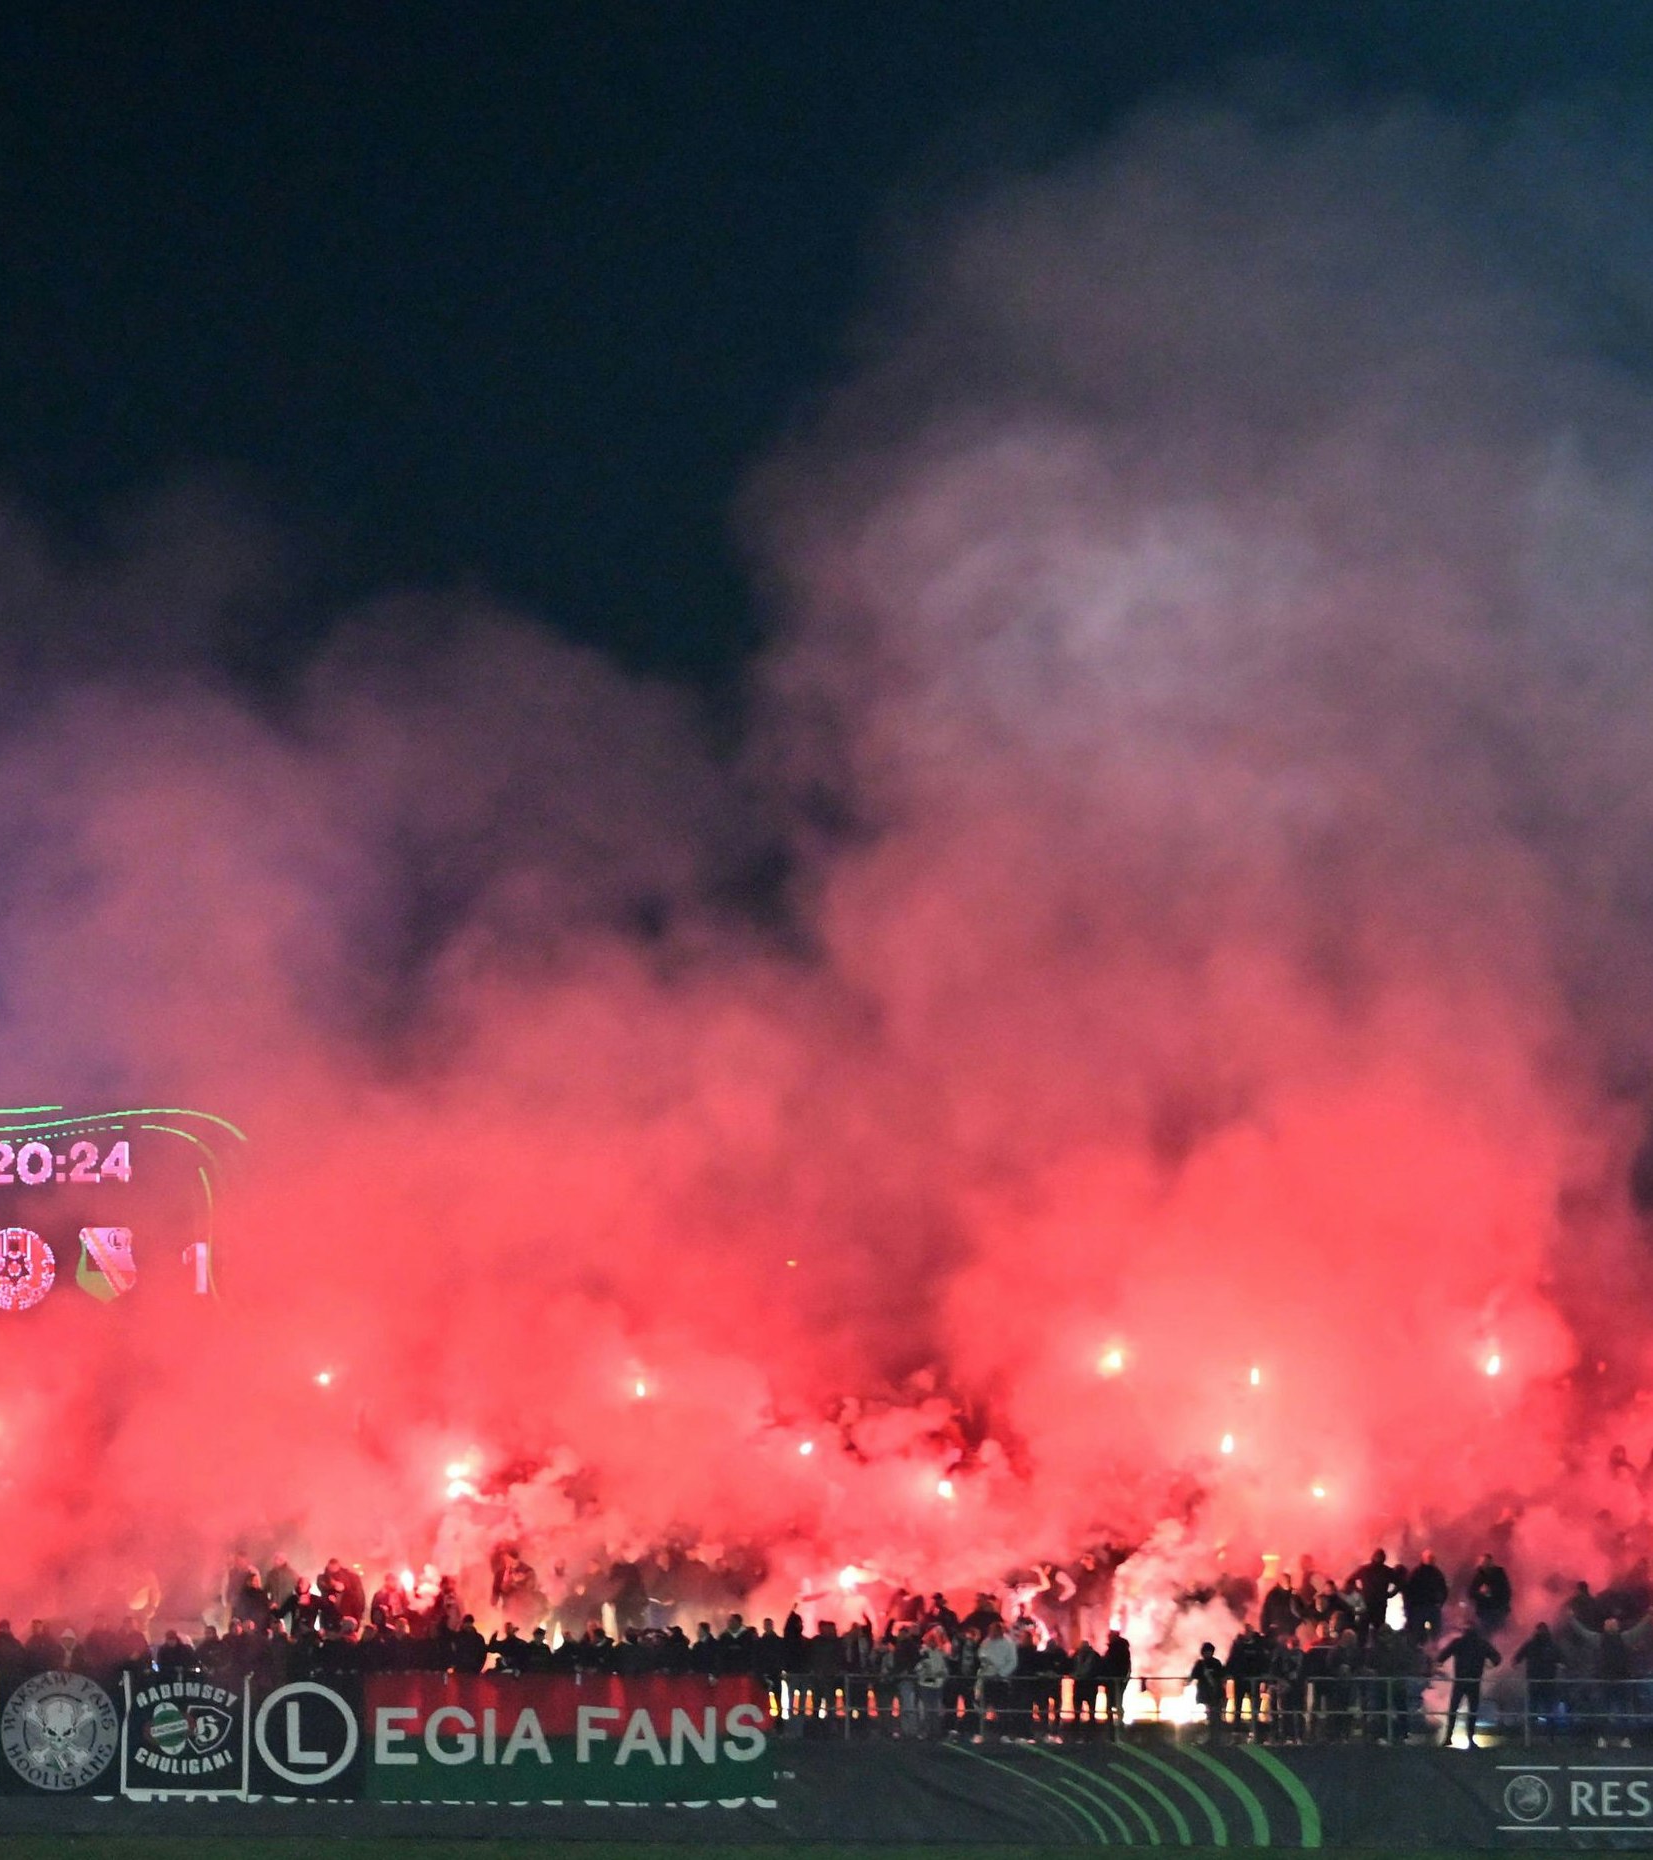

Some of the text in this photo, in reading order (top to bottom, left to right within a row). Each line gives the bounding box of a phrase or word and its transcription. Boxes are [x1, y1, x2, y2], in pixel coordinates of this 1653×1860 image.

[575, 1703, 768, 1766] FANS
[134, 1747, 233, 1775] CHULIGANI
[1570, 1781, 1653, 1817] RES
